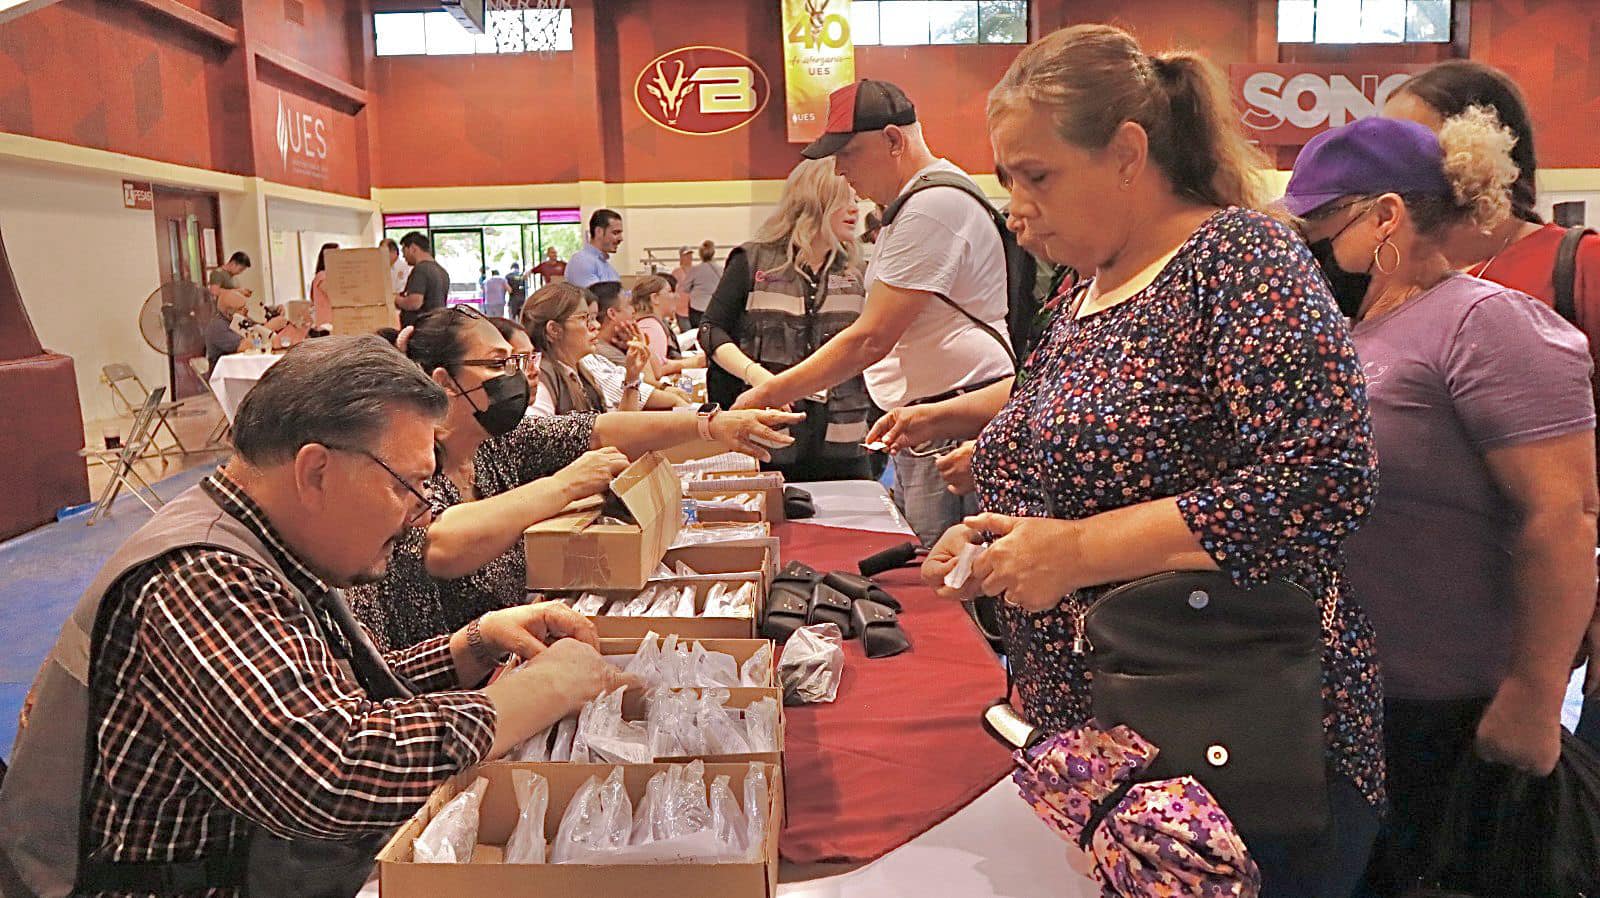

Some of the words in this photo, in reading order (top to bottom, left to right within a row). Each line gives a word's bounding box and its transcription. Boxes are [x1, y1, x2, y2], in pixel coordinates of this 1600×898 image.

[808, 67, 831, 76] UES
[797, 113, 816, 121] UES
[287, 109, 327, 158] UES
